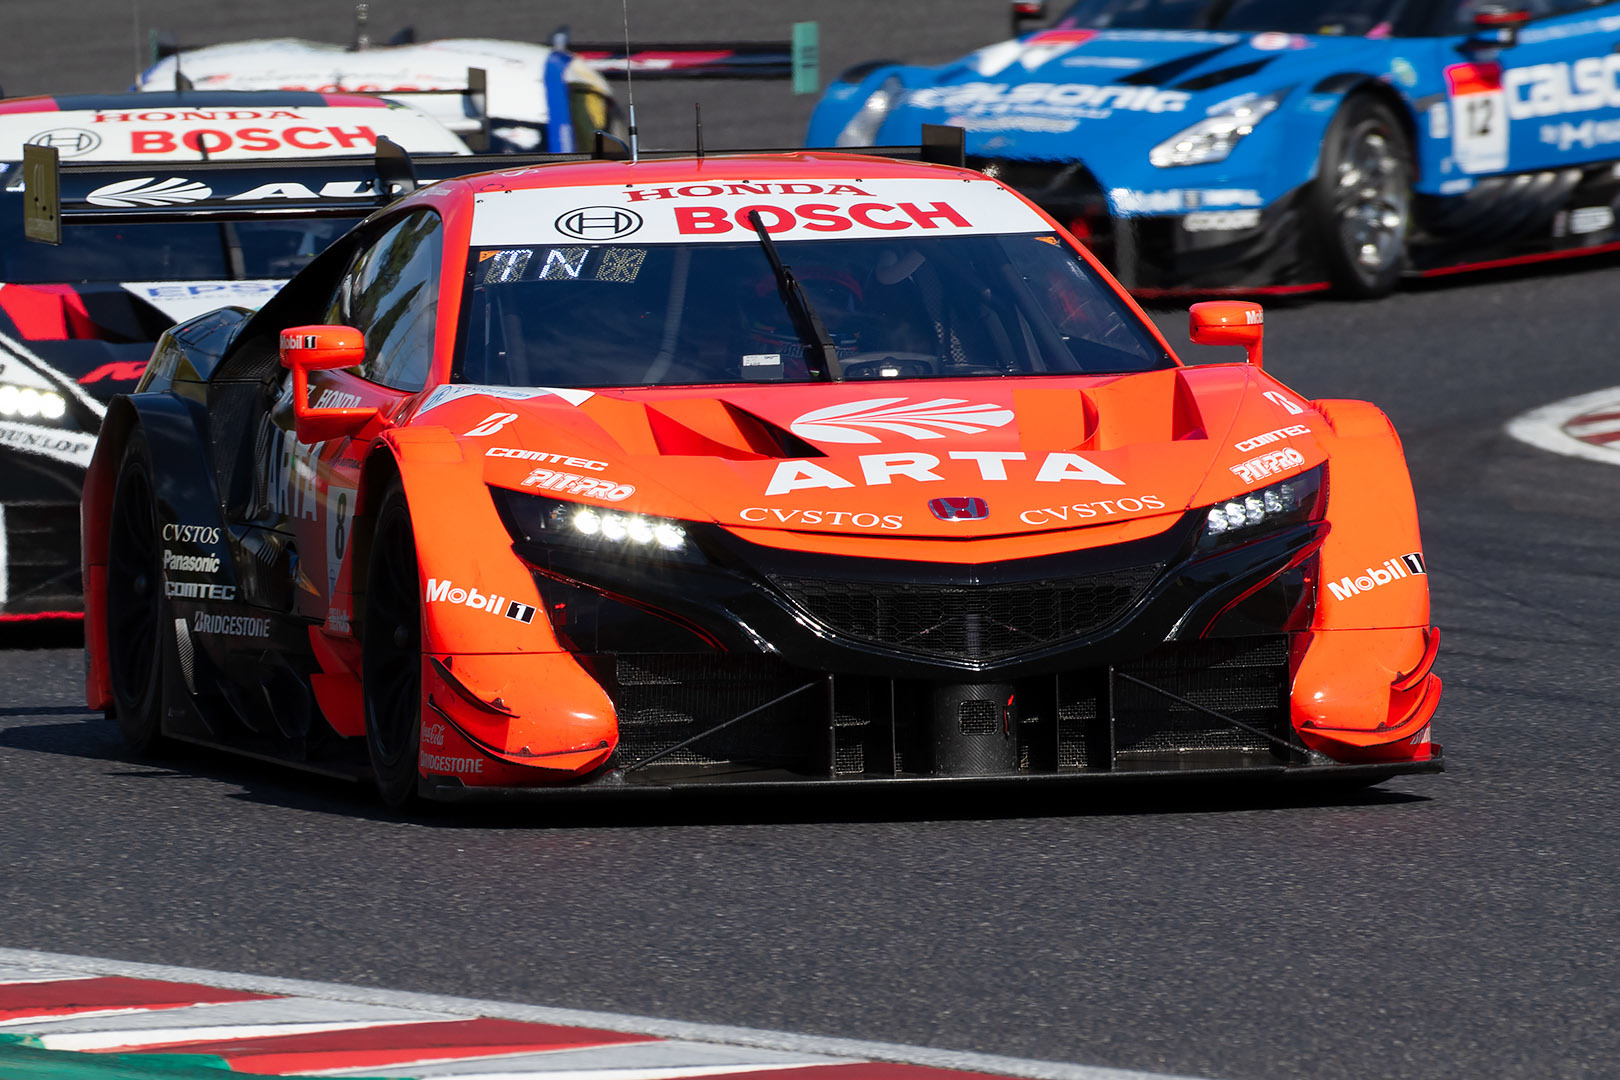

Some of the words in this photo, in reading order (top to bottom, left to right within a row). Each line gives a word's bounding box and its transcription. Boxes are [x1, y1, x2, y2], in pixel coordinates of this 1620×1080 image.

[91, 110, 309, 123] HONDA
[130, 125, 378, 154] BOSCH
[625, 183, 877, 202] HONDA
[673, 201, 974, 235] BOSCH
[1234, 424, 1312, 452] COMTEC
[485, 447, 609, 471] COMTEC
[764, 450, 1126, 496] ARTA
[739, 507, 903, 530] CVSTOS
[1019, 495, 1165, 526] CVSTOS
[162, 523, 220, 545] CVSTOS
[335, 492, 347, 560] 8
[163, 549, 220, 573] Panasonic
[165, 581, 236, 601] COMTEC
[1327, 558, 1407, 602] Mobil
[426, 578, 505, 616] Mobil
[194, 611, 271, 638] BRIDGESTONE
